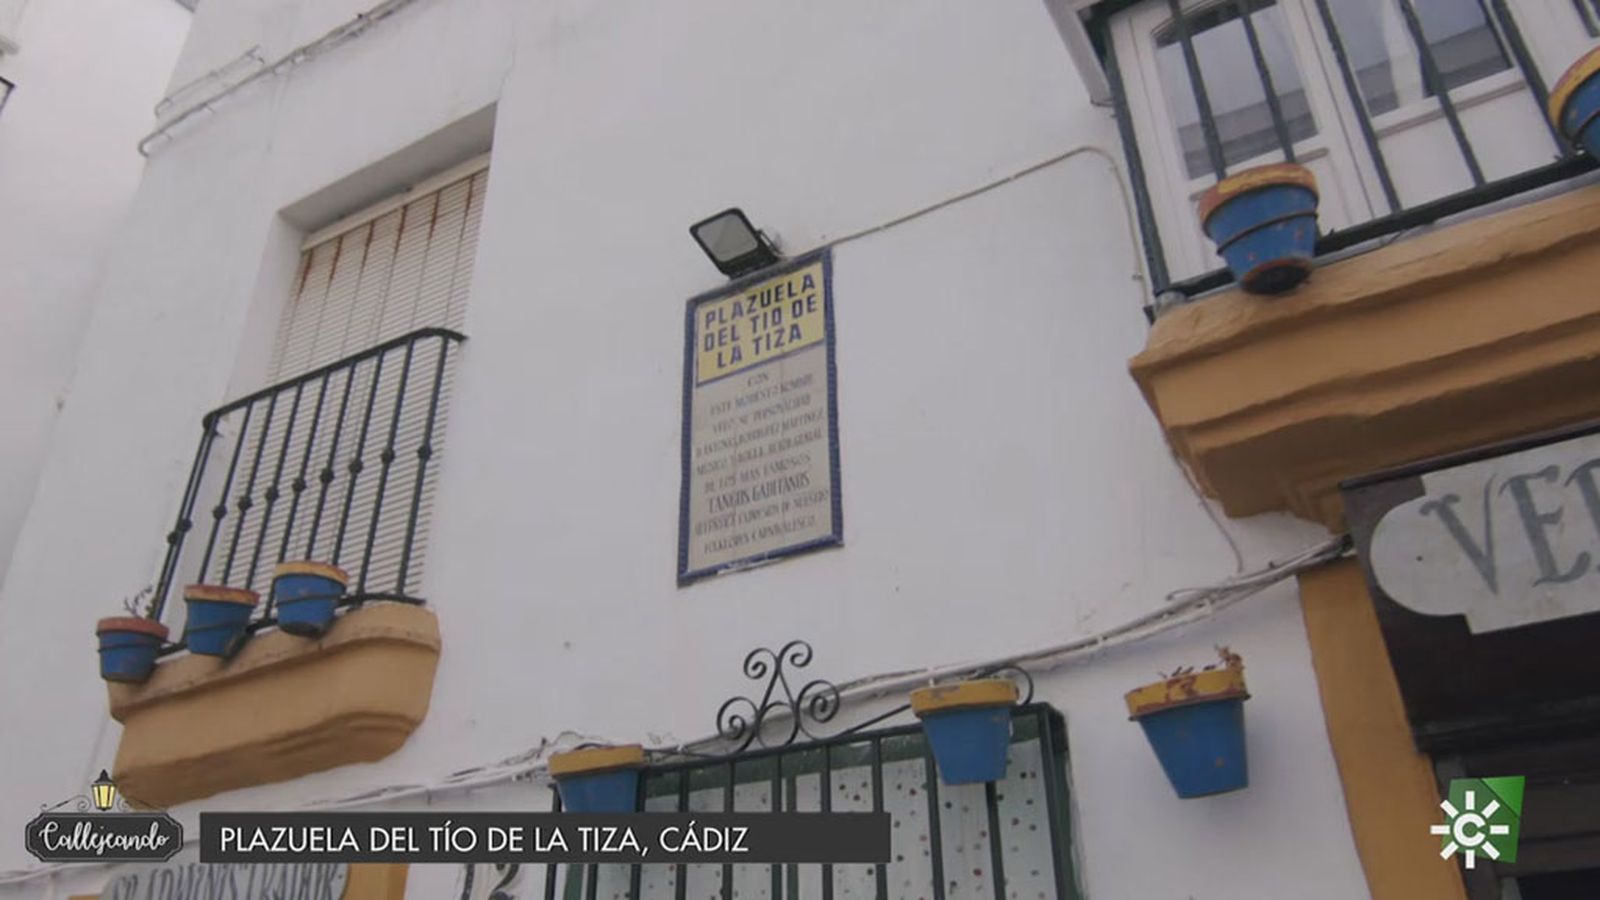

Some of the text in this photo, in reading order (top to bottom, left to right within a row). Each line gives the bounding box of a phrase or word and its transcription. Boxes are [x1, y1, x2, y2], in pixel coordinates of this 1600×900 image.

[703, 293, 817, 353] DEL TIO DE
[704, 273, 816, 331] PLAZUELA
[717, 323, 802, 369] LA TIZA
